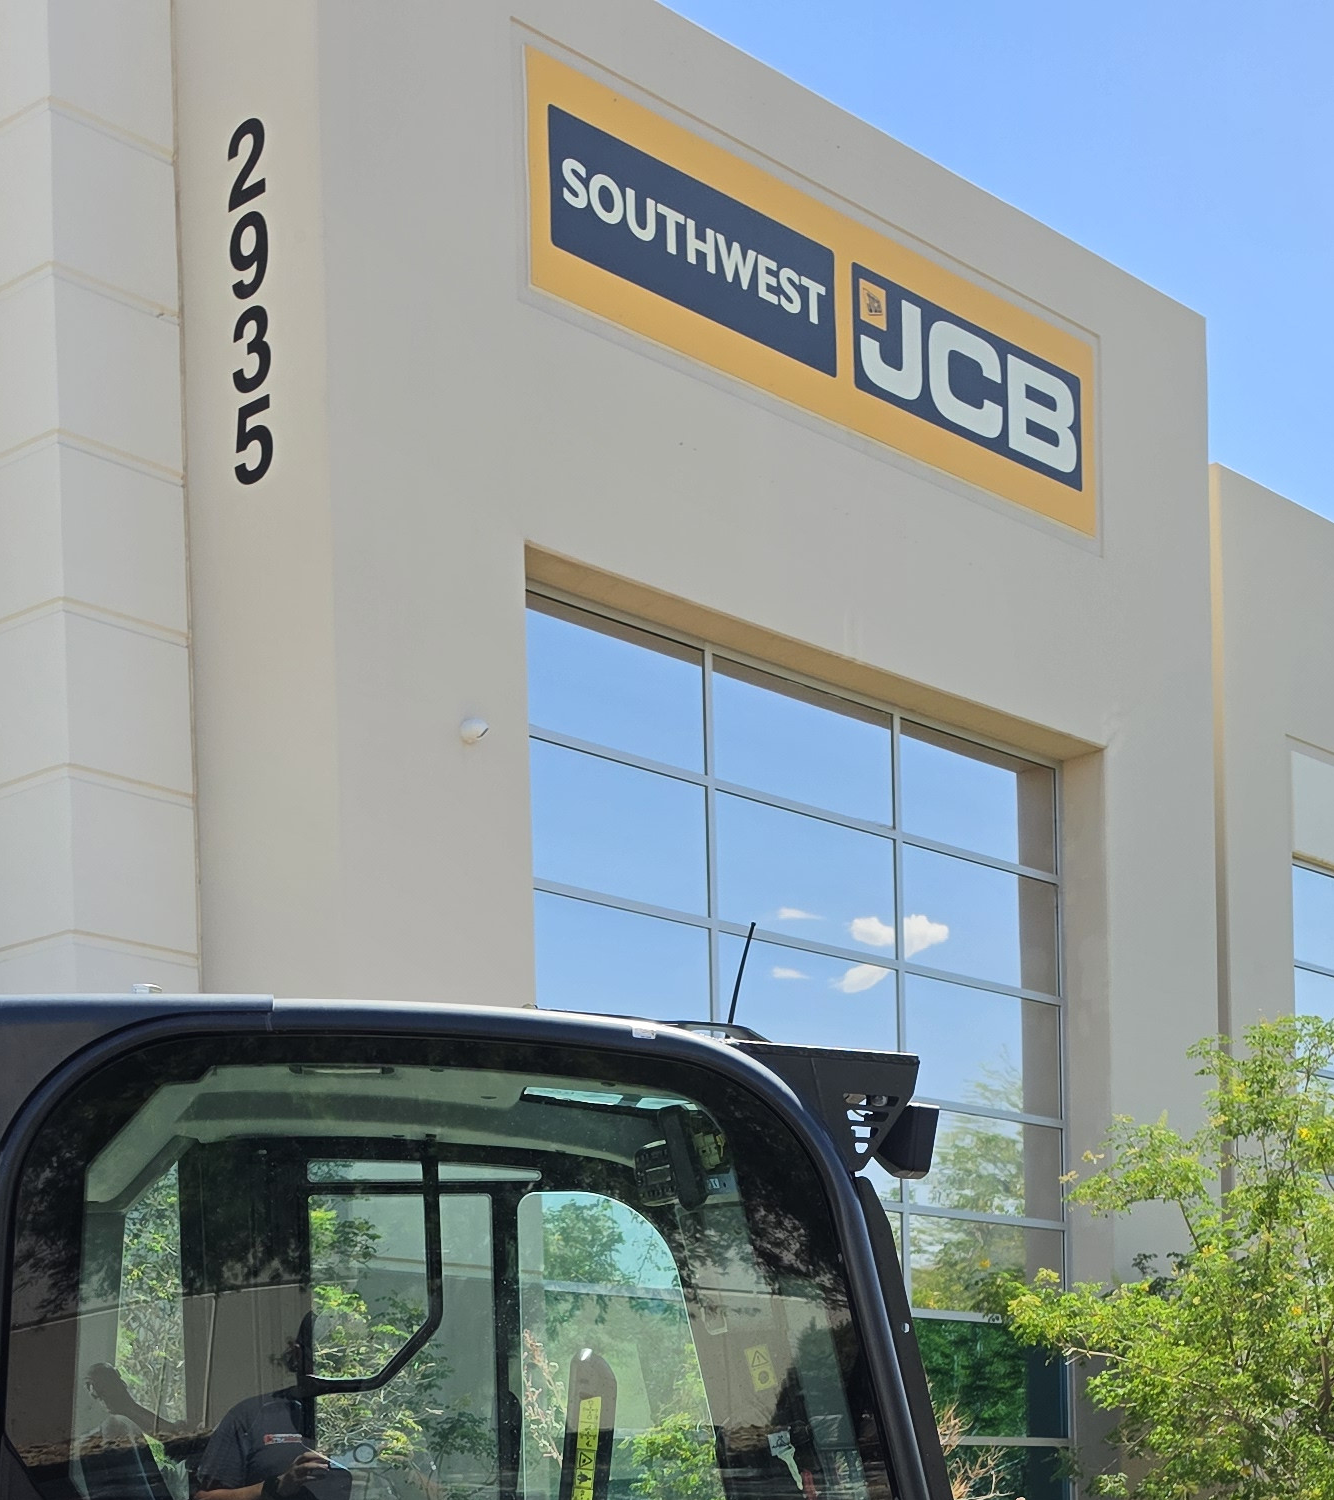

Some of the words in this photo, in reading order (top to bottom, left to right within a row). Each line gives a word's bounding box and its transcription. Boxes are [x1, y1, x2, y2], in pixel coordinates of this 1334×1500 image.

[227, 117, 274, 486] 2935
[561, 158, 827, 325] SOUTHWEST
[860, 299, 1078, 474] JCB
